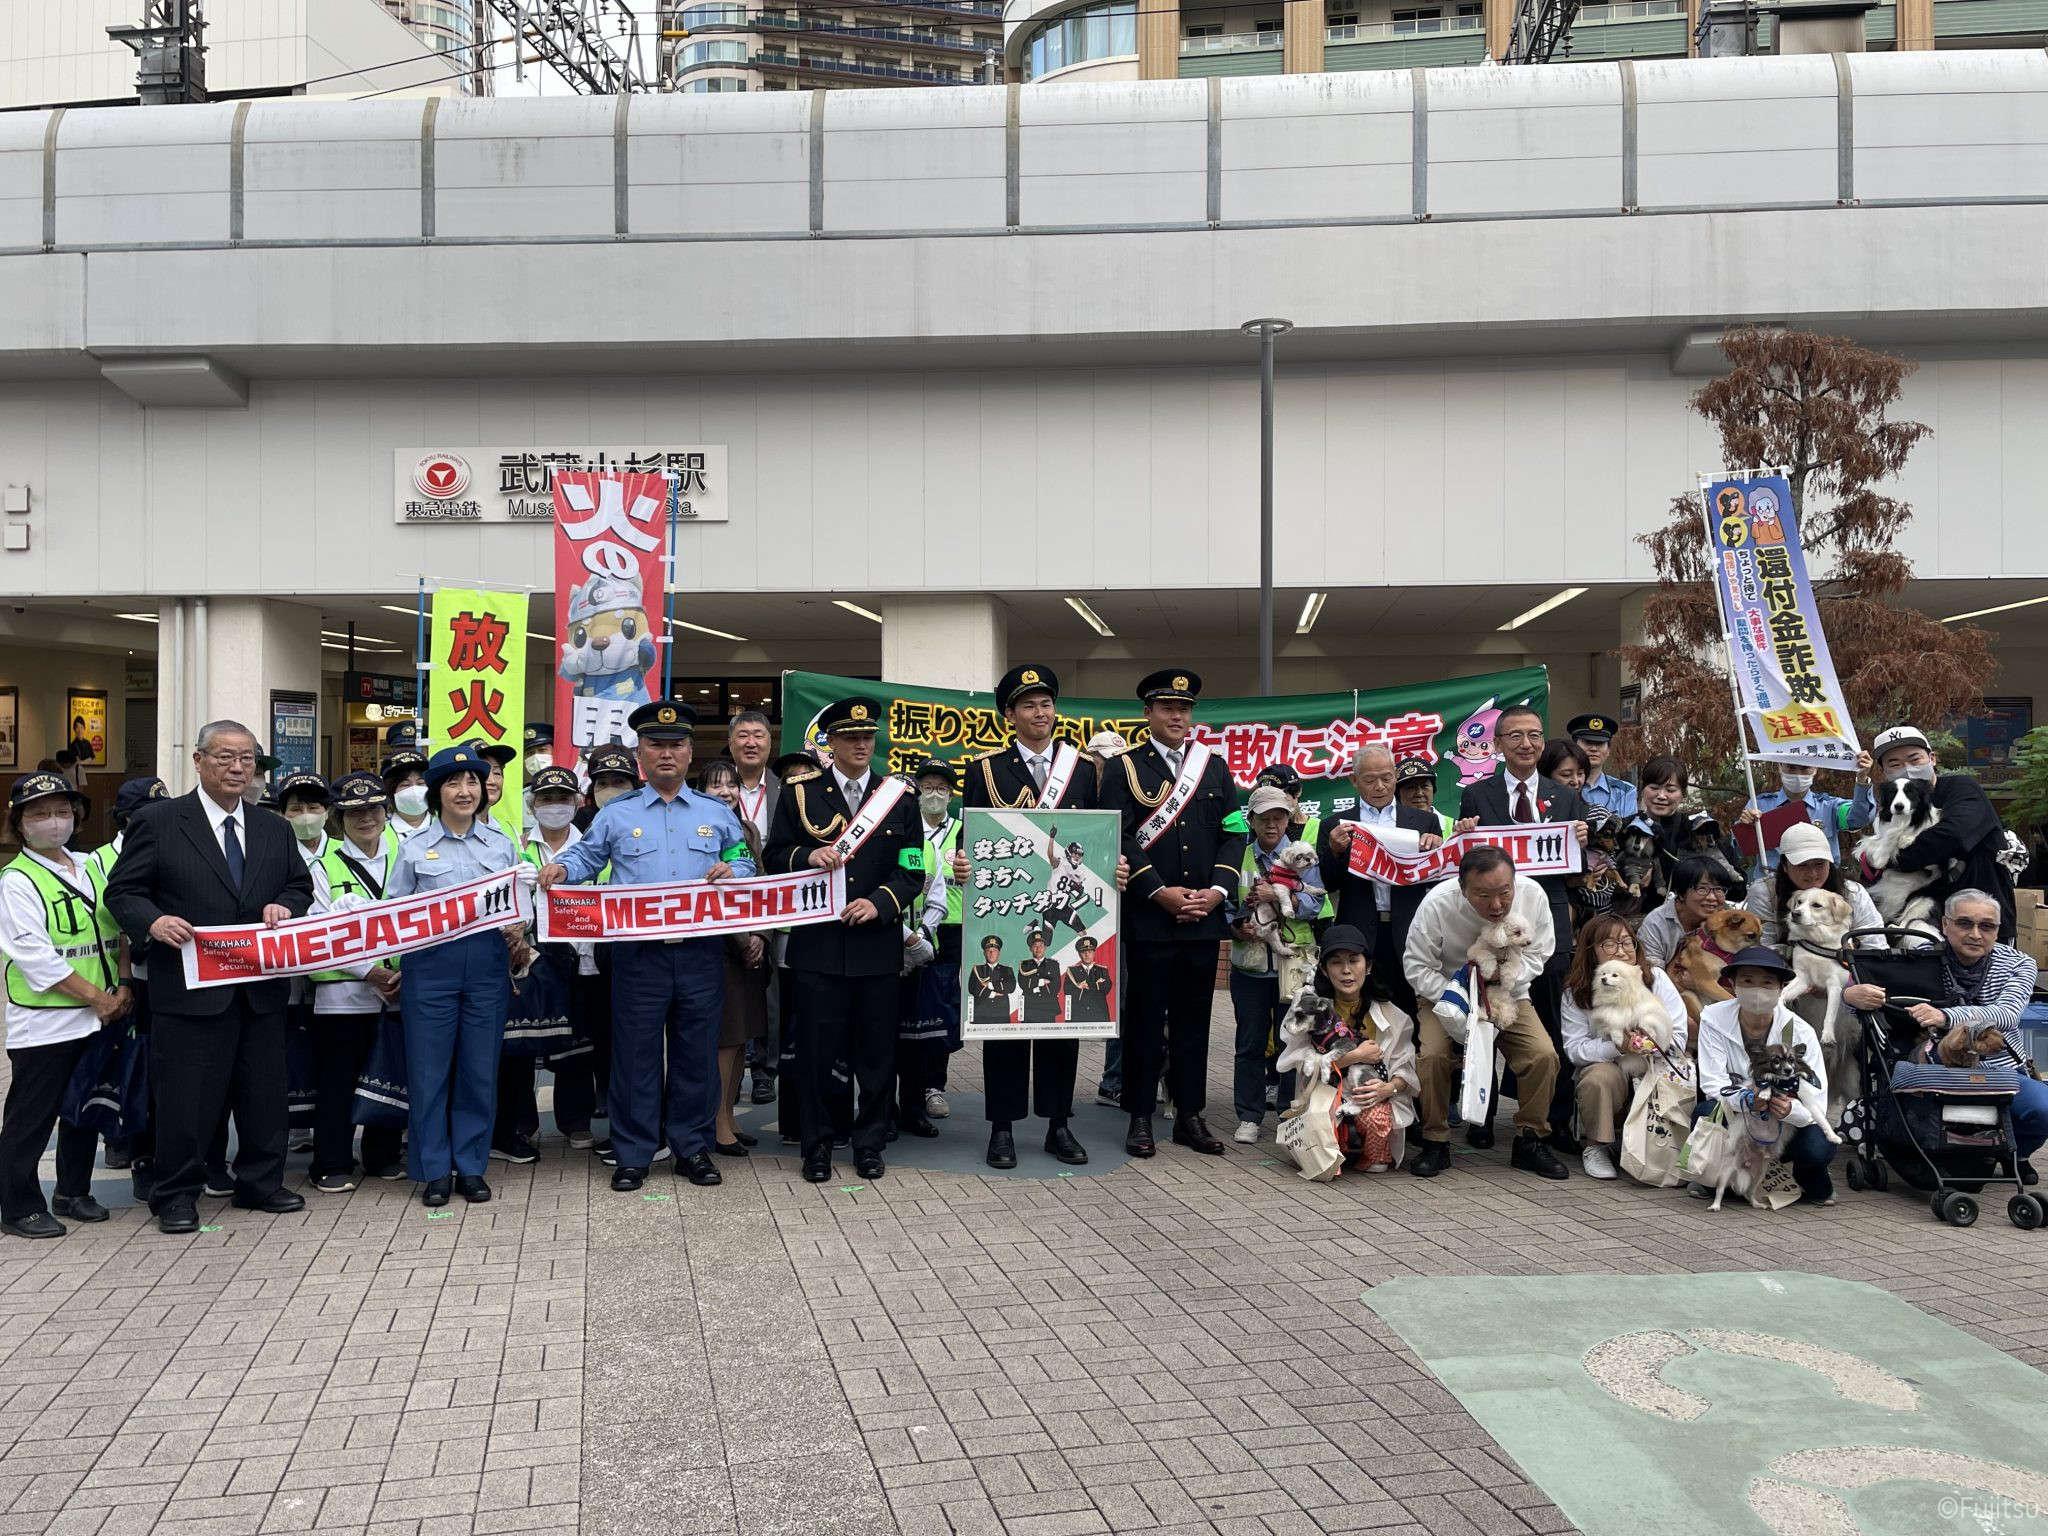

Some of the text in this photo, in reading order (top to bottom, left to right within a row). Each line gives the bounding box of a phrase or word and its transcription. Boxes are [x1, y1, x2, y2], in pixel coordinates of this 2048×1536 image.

[405, 501, 482, 518] 東急電鉄
[1738, 549, 1758, 601] ちょっと待て
[1755, 547, 1827, 704] 還付金詐欺
[447, 611, 509, 741] 放火
[973, 836, 1035, 861] 安全な
[973, 866, 1034, 889] まちへ
[553, 898, 597, 906] NAKAHARA
[554, 906, 579, 917] Safety
[575, 915, 590, 923] and
[566, 922, 598, 932] Security
[201, 938, 254, 949] NAKAHARA
[203, 947, 230, 957] Safety
[219, 962, 255, 971] Security
